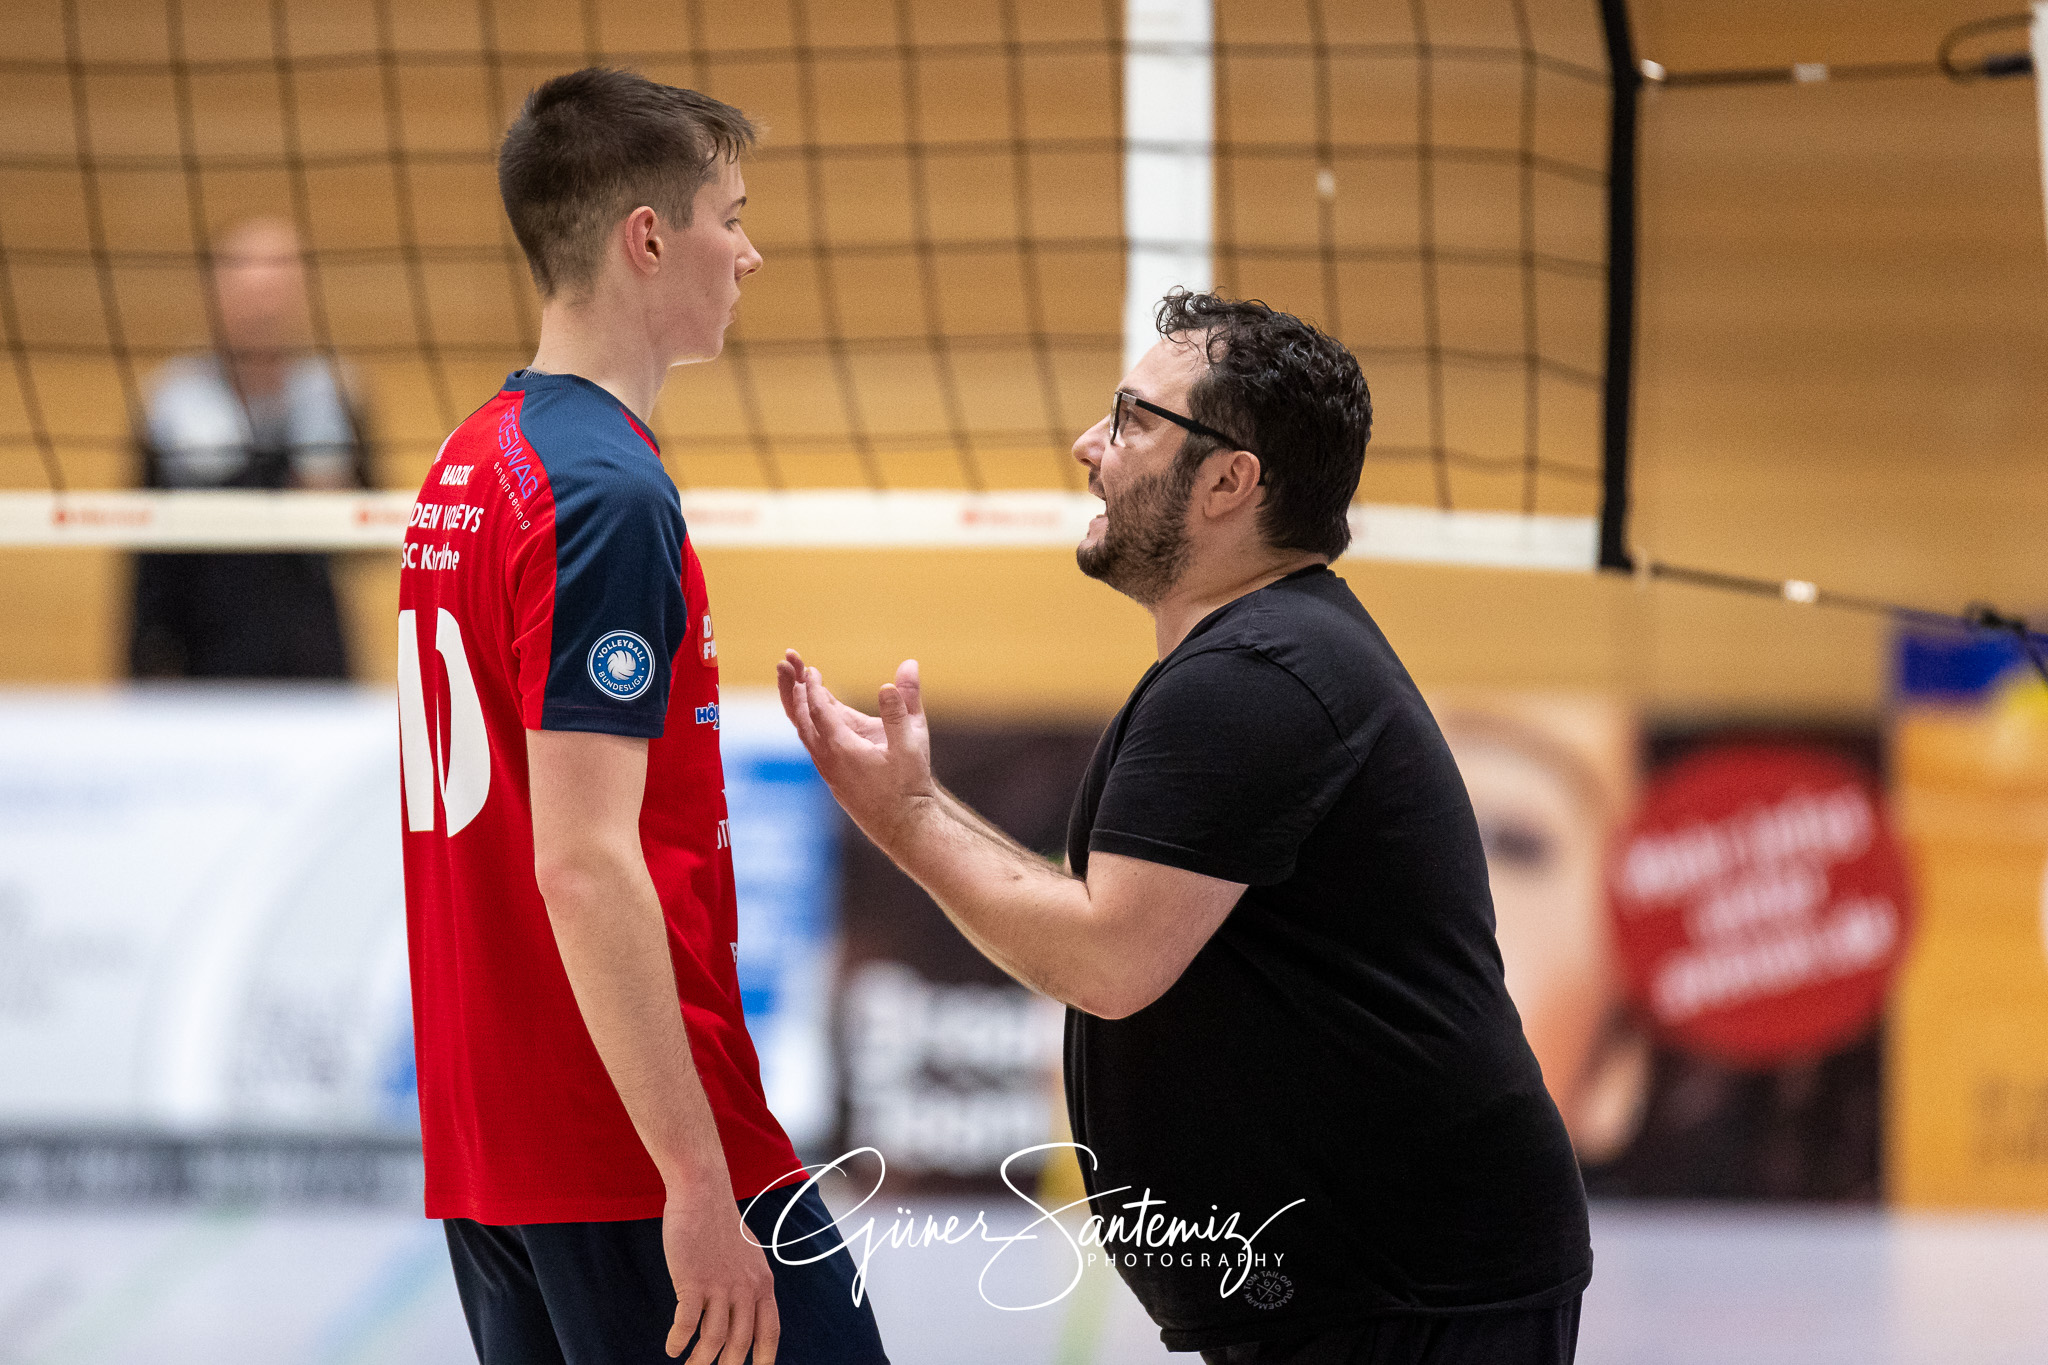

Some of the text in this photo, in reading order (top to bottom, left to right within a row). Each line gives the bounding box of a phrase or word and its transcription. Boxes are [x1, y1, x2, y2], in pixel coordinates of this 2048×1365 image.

[493, 461, 531, 530] engineering
[597, 639, 646, 663] VOLLEYBALL
[598, 670, 645, 692] BUNDESLIGA
[1243, 1270, 1293, 1290] TOM TAILOR
[1244, 1289, 1294, 1310] TRADEMARK
